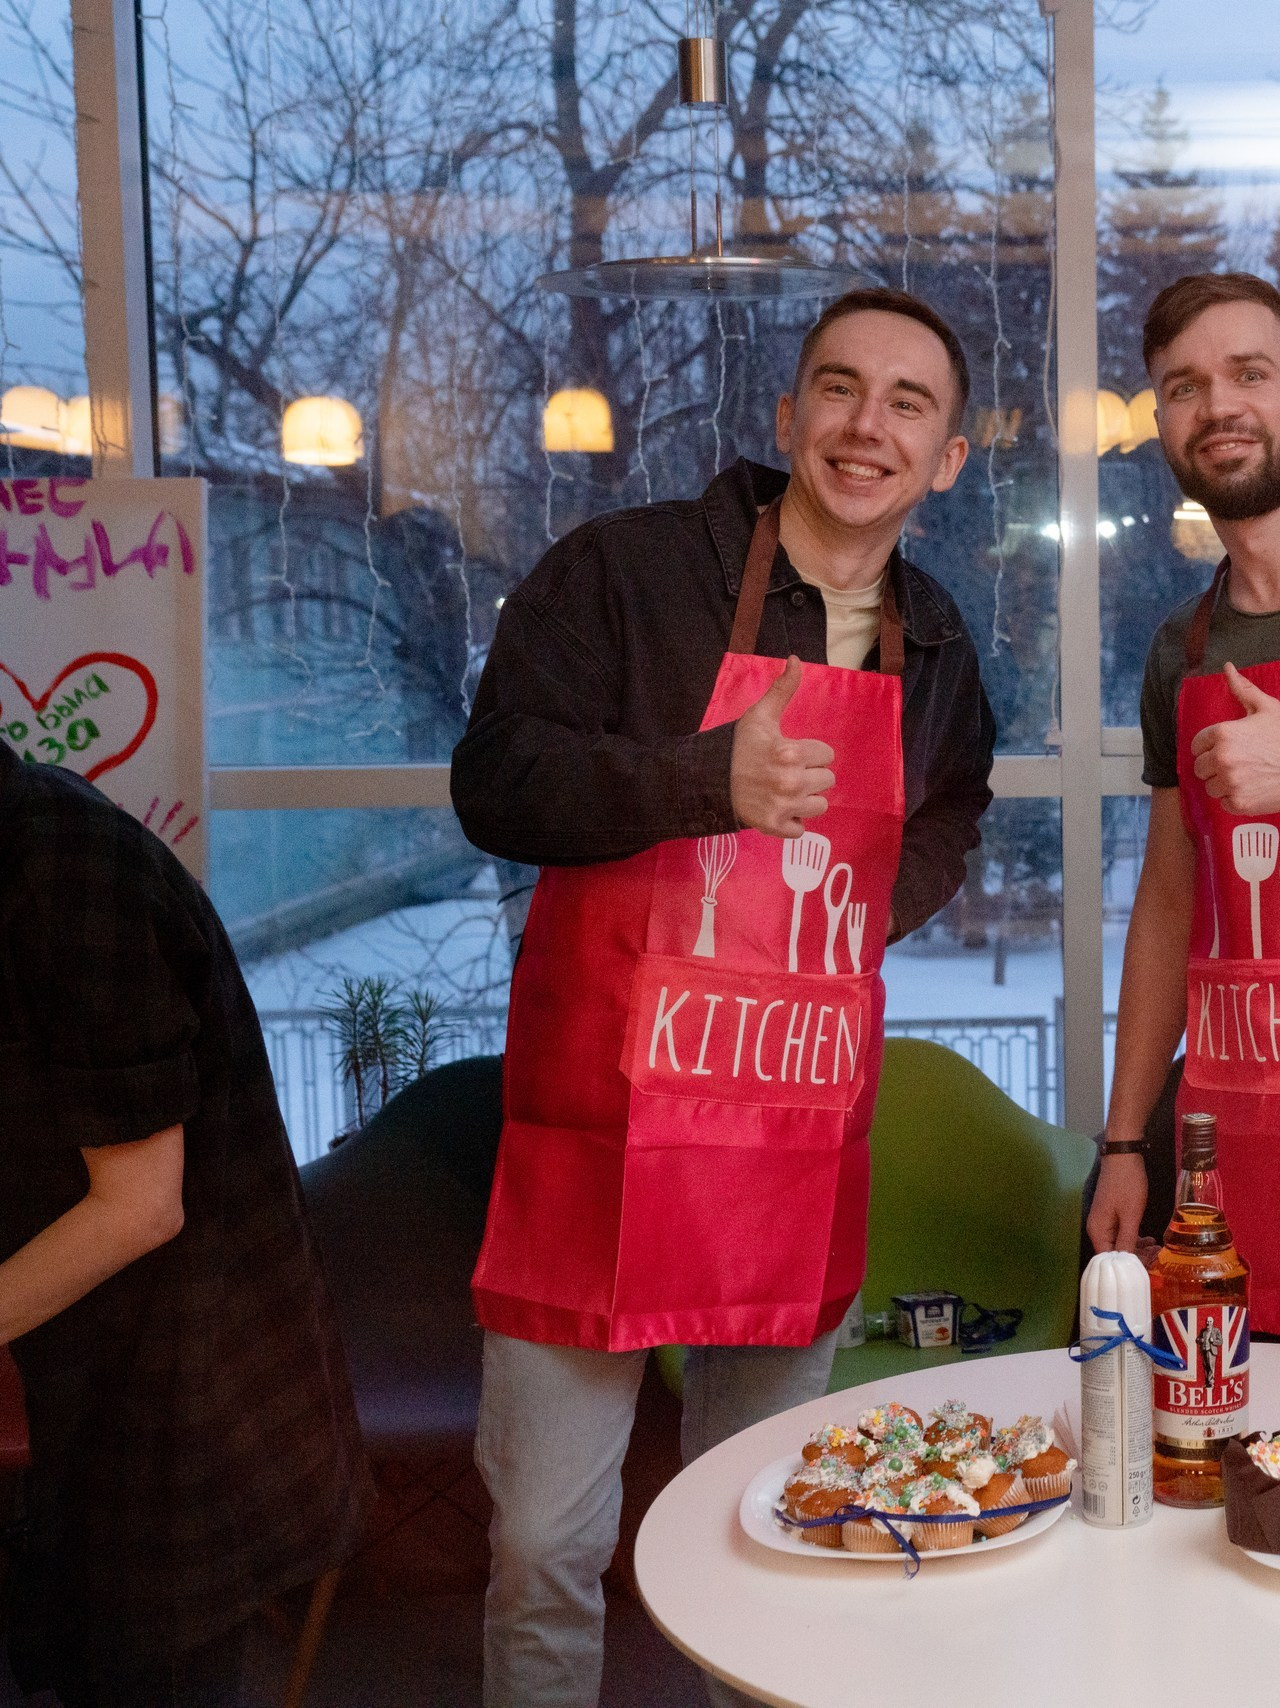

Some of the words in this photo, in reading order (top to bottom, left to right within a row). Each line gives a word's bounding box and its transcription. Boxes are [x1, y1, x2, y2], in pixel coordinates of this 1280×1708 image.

[648, 986, 863, 1084] KITCHEN
[1168, 1379, 1244, 1408] BELL'S
[1201, 1406, 1224, 1415] SCOTCH
